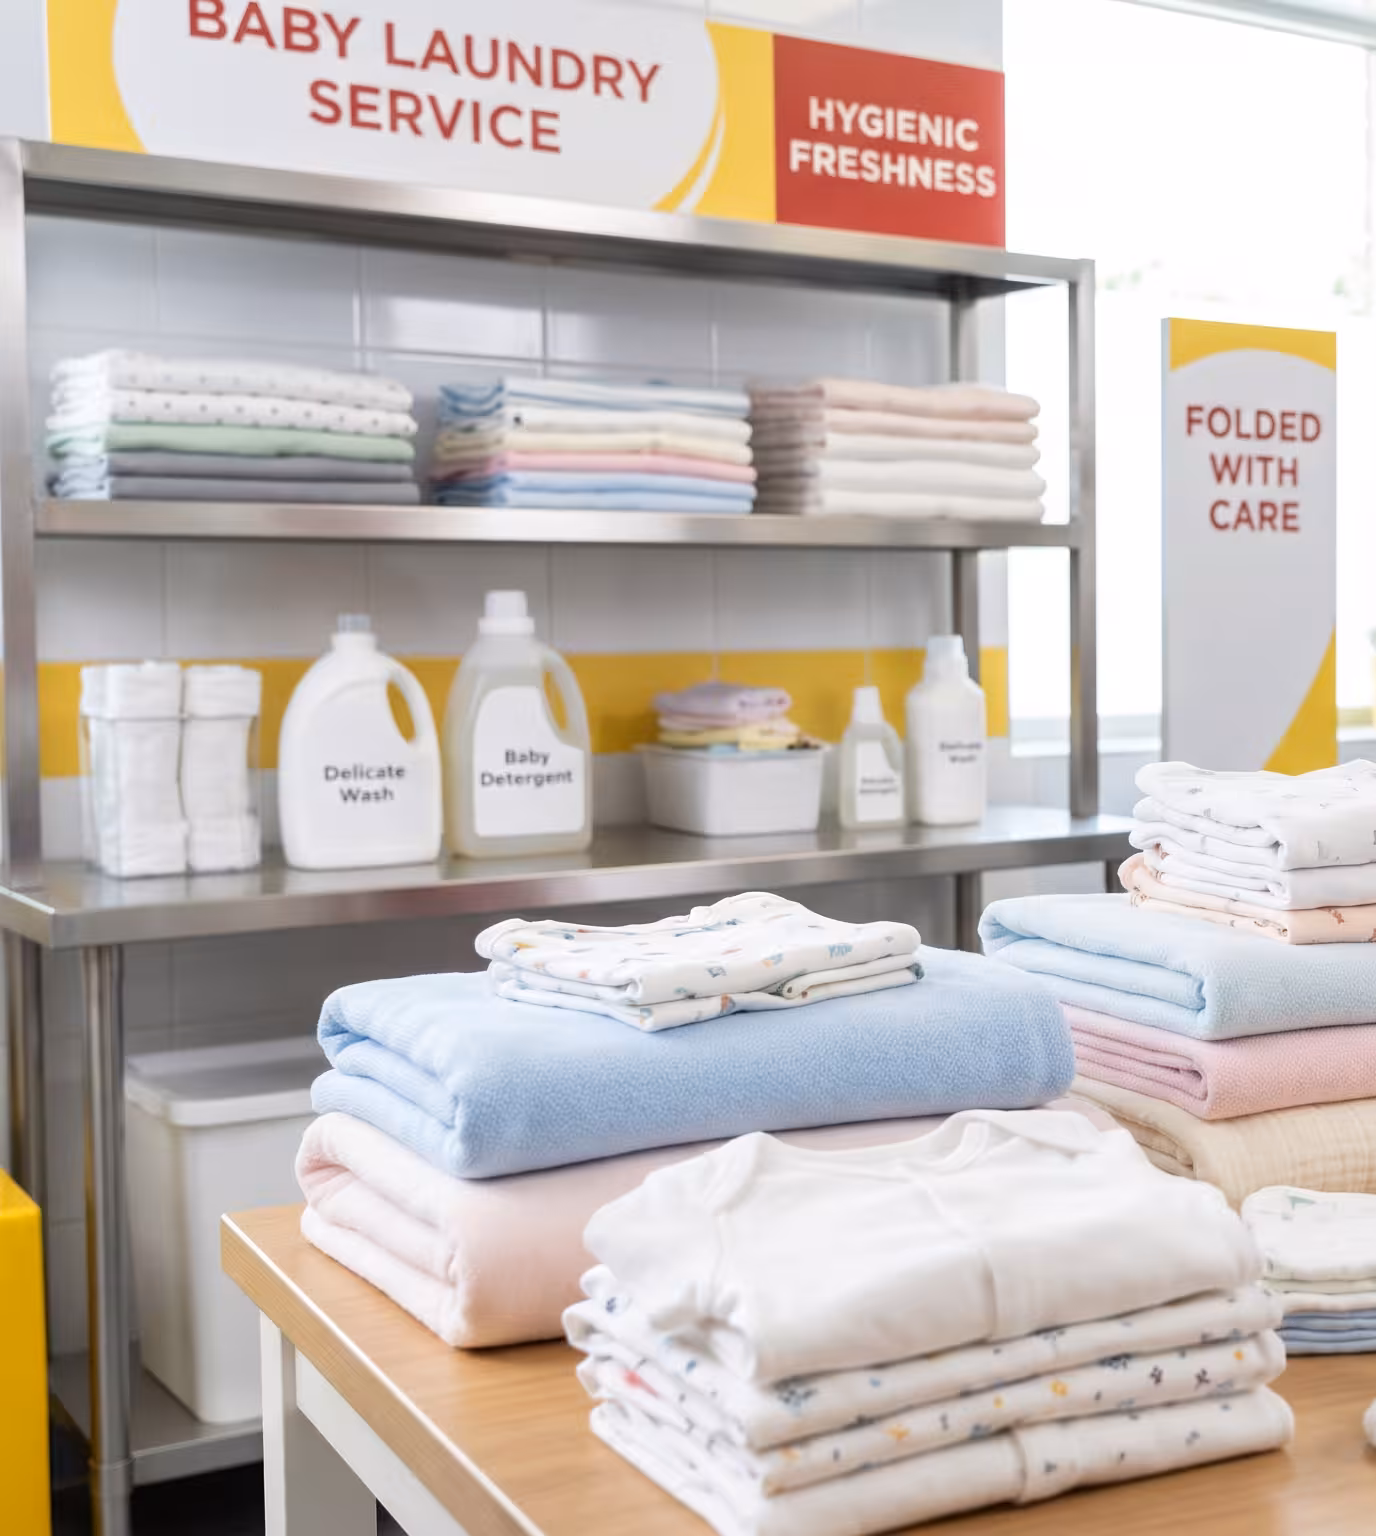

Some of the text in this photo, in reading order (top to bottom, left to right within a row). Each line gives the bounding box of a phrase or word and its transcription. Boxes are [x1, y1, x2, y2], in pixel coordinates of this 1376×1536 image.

[189, 0, 660, 103] BABY LAUNDRY
[309, 79, 561, 153] SERVICE
[809, 96, 979, 152] HYGIENIC
[790, 139, 997, 198] FRESHNESS
[1186, 405, 1321, 443] FOLDED
[1209, 453, 1299, 487] WITH
[1209, 499, 1300, 533] CARE
[324, 764, 406, 782] Delicate
[505, 749, 550, 766] Baby
[339, 786, 394, 803] Wash
[480, 770, 573, 788] Detergent
